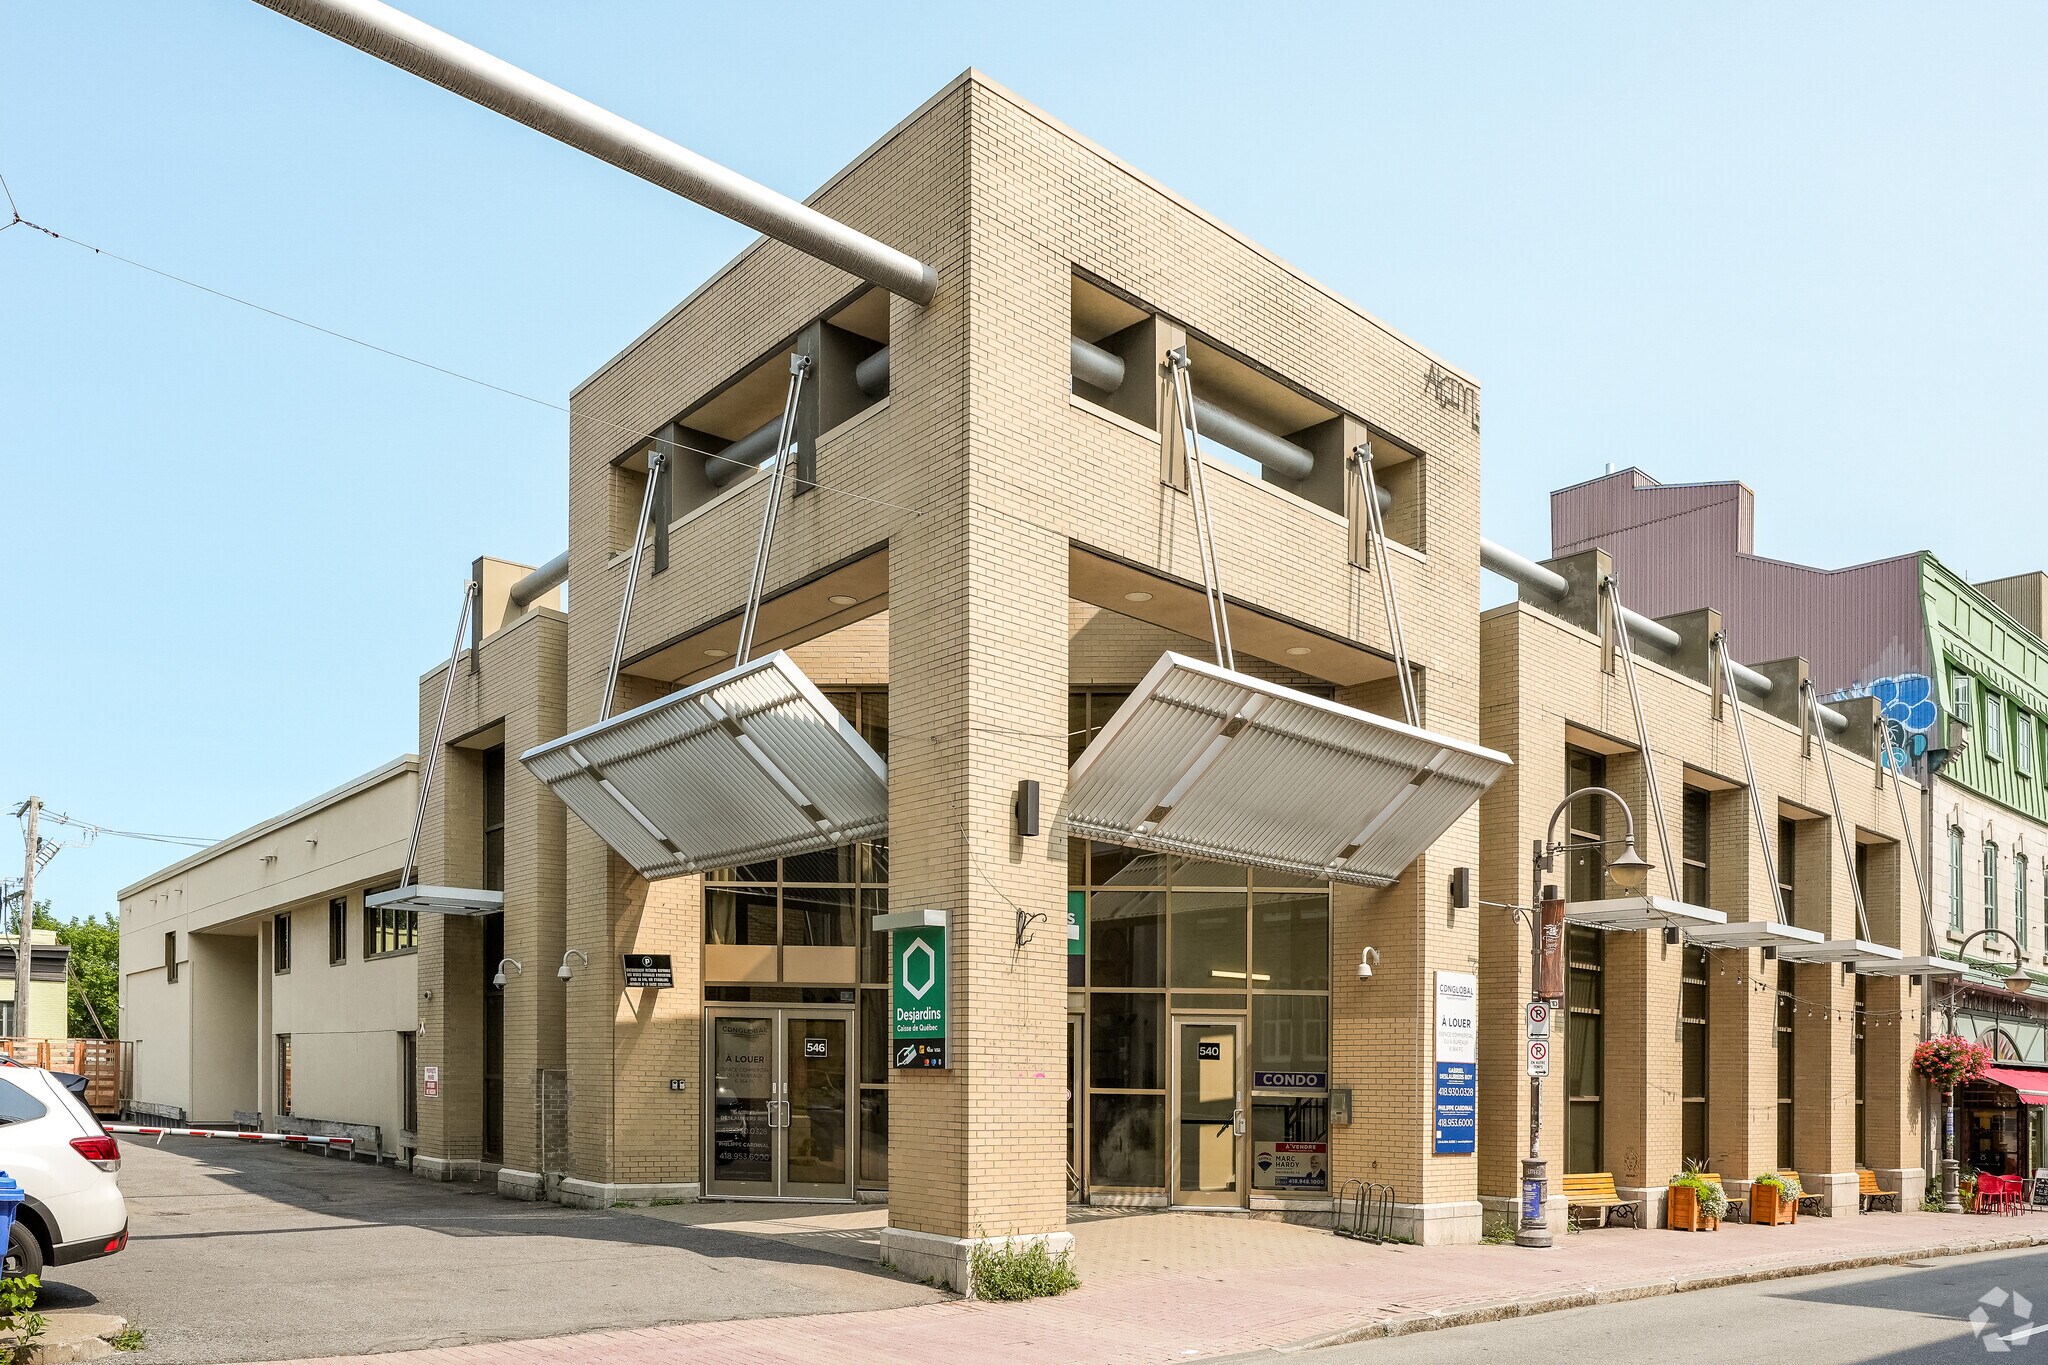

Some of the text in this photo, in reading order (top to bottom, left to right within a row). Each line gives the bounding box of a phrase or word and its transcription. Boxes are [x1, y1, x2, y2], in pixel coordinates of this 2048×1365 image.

[896, 1006, 941, 1023] Desjardins
[1442, 1014, 1471, 1028] À LOUER
[896, 1024, 911, 1032] Caisse
[919, 1023, 938, 1031] Québec
[806, 1042, 825, 1052] 546
[1199, 1046, 1219, 1056] 540
[735, 1055, 765, 1063] LOUER
[1263, 1074, 1318, 1086] CONDO
[1438, 1087, 1474, 1097] 418.930.0328
[1437, 1118, 1474, 1127] 418.953.6000
